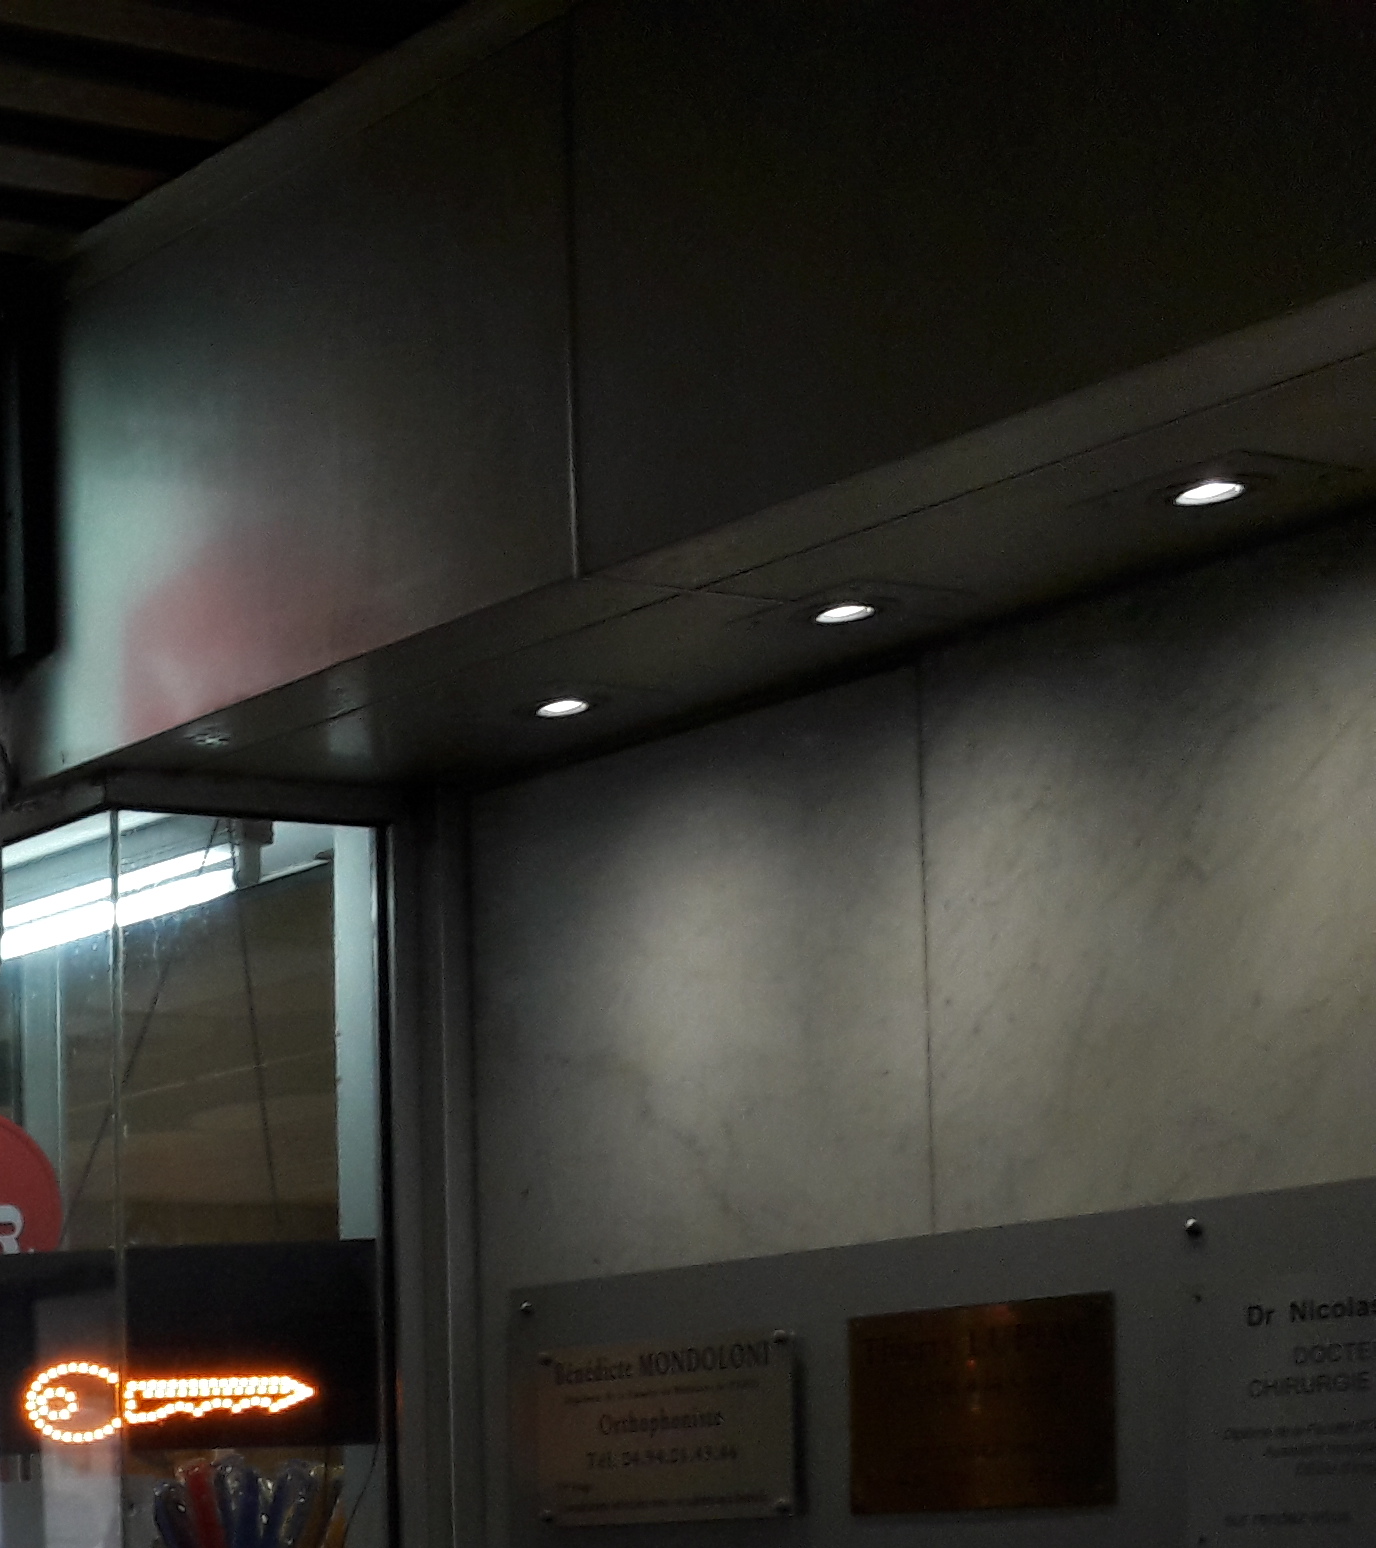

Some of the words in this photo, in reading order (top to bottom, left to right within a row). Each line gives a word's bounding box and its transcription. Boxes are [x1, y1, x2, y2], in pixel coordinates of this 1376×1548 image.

[1247, 1304, 1275, 1327] Dr
[638, 1340, 771, 1377] MONDOLONI
[1295, 1341, 1376, 1364] DOCTE
[1248, 1371, 1372, 1399] CHIRURGIE
[598, 1407, 724, 1438] Orthophoniste
